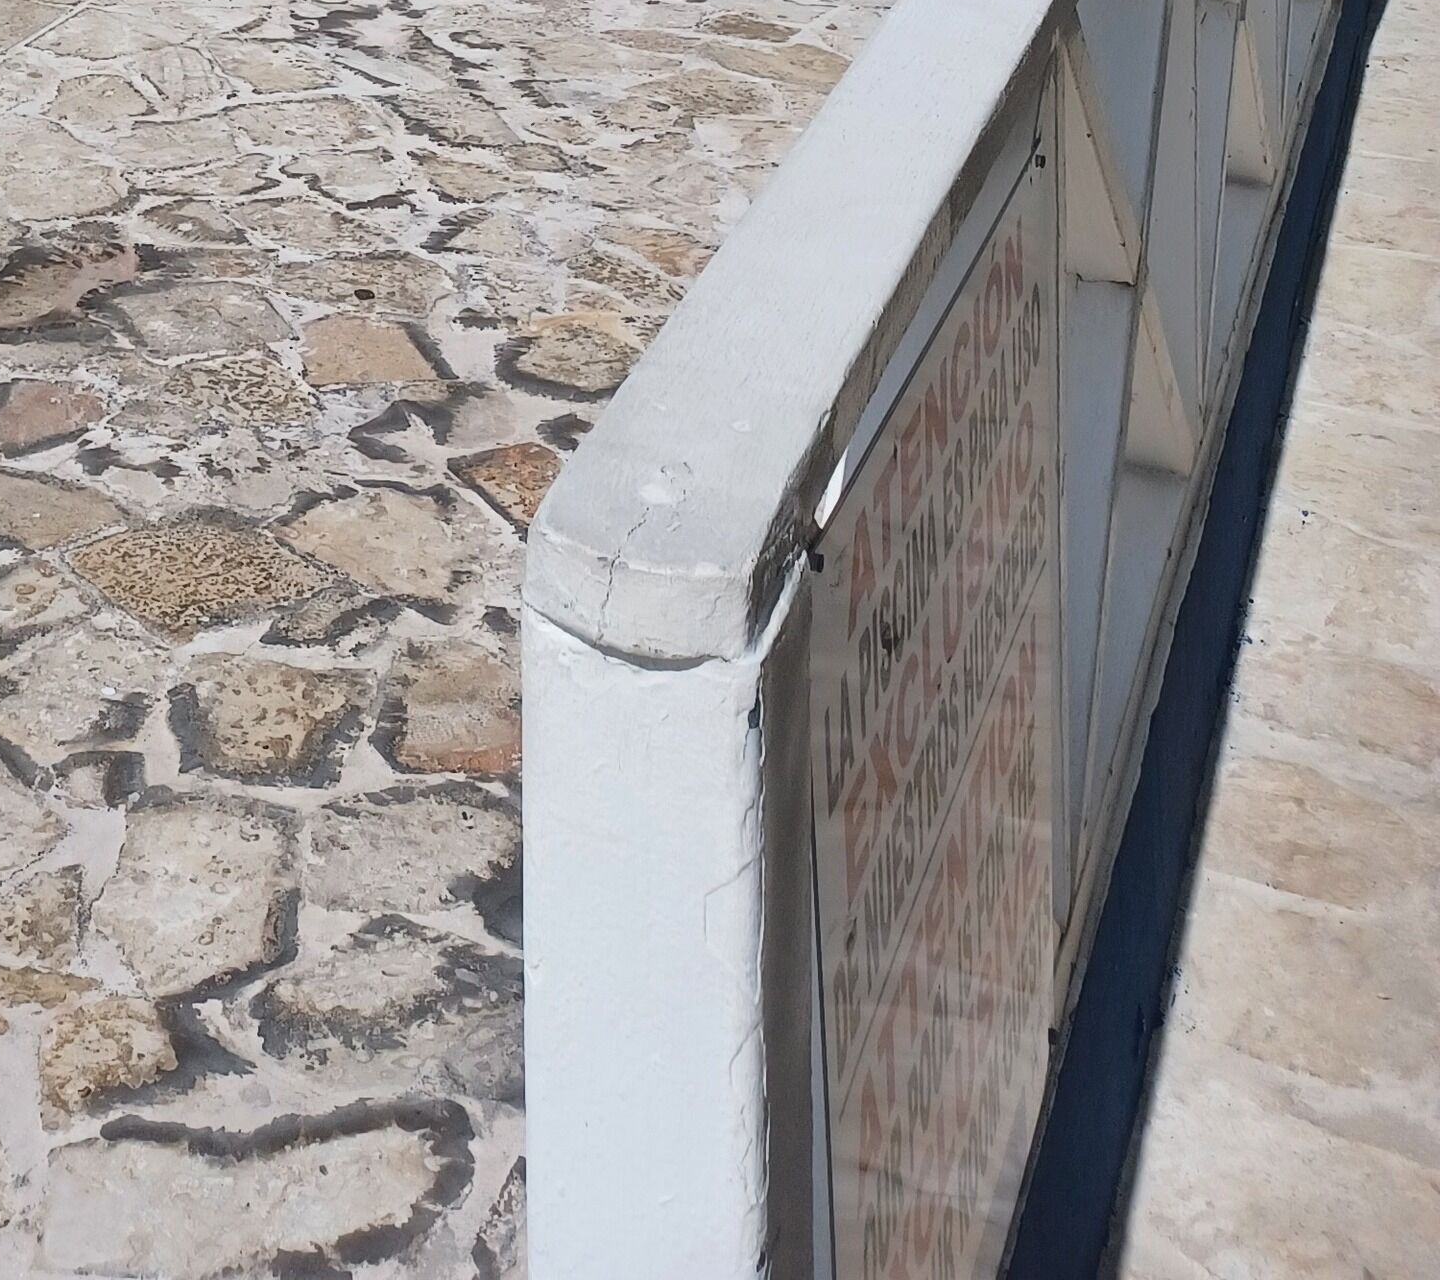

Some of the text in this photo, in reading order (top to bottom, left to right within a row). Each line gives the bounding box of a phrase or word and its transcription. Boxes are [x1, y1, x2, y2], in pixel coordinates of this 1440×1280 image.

[824, 281, 1041, 820] LA PISCINA ES PARA USO
[843, 400, 1033, 913] EXCLUSIVO
[847, 212, 1023, 641] ATENCIÓN
[832, 464, 1046, 1084] DE NUESTROS HUESPEDES
[856, 610, 1036, 1224] ATTENTION
[907, 971, 954, 1173] POOL
[957, 898, 973, 1019] IS
[976, 800, 1005, 958] FOR
[1008, 710, 1036, 854] THE
